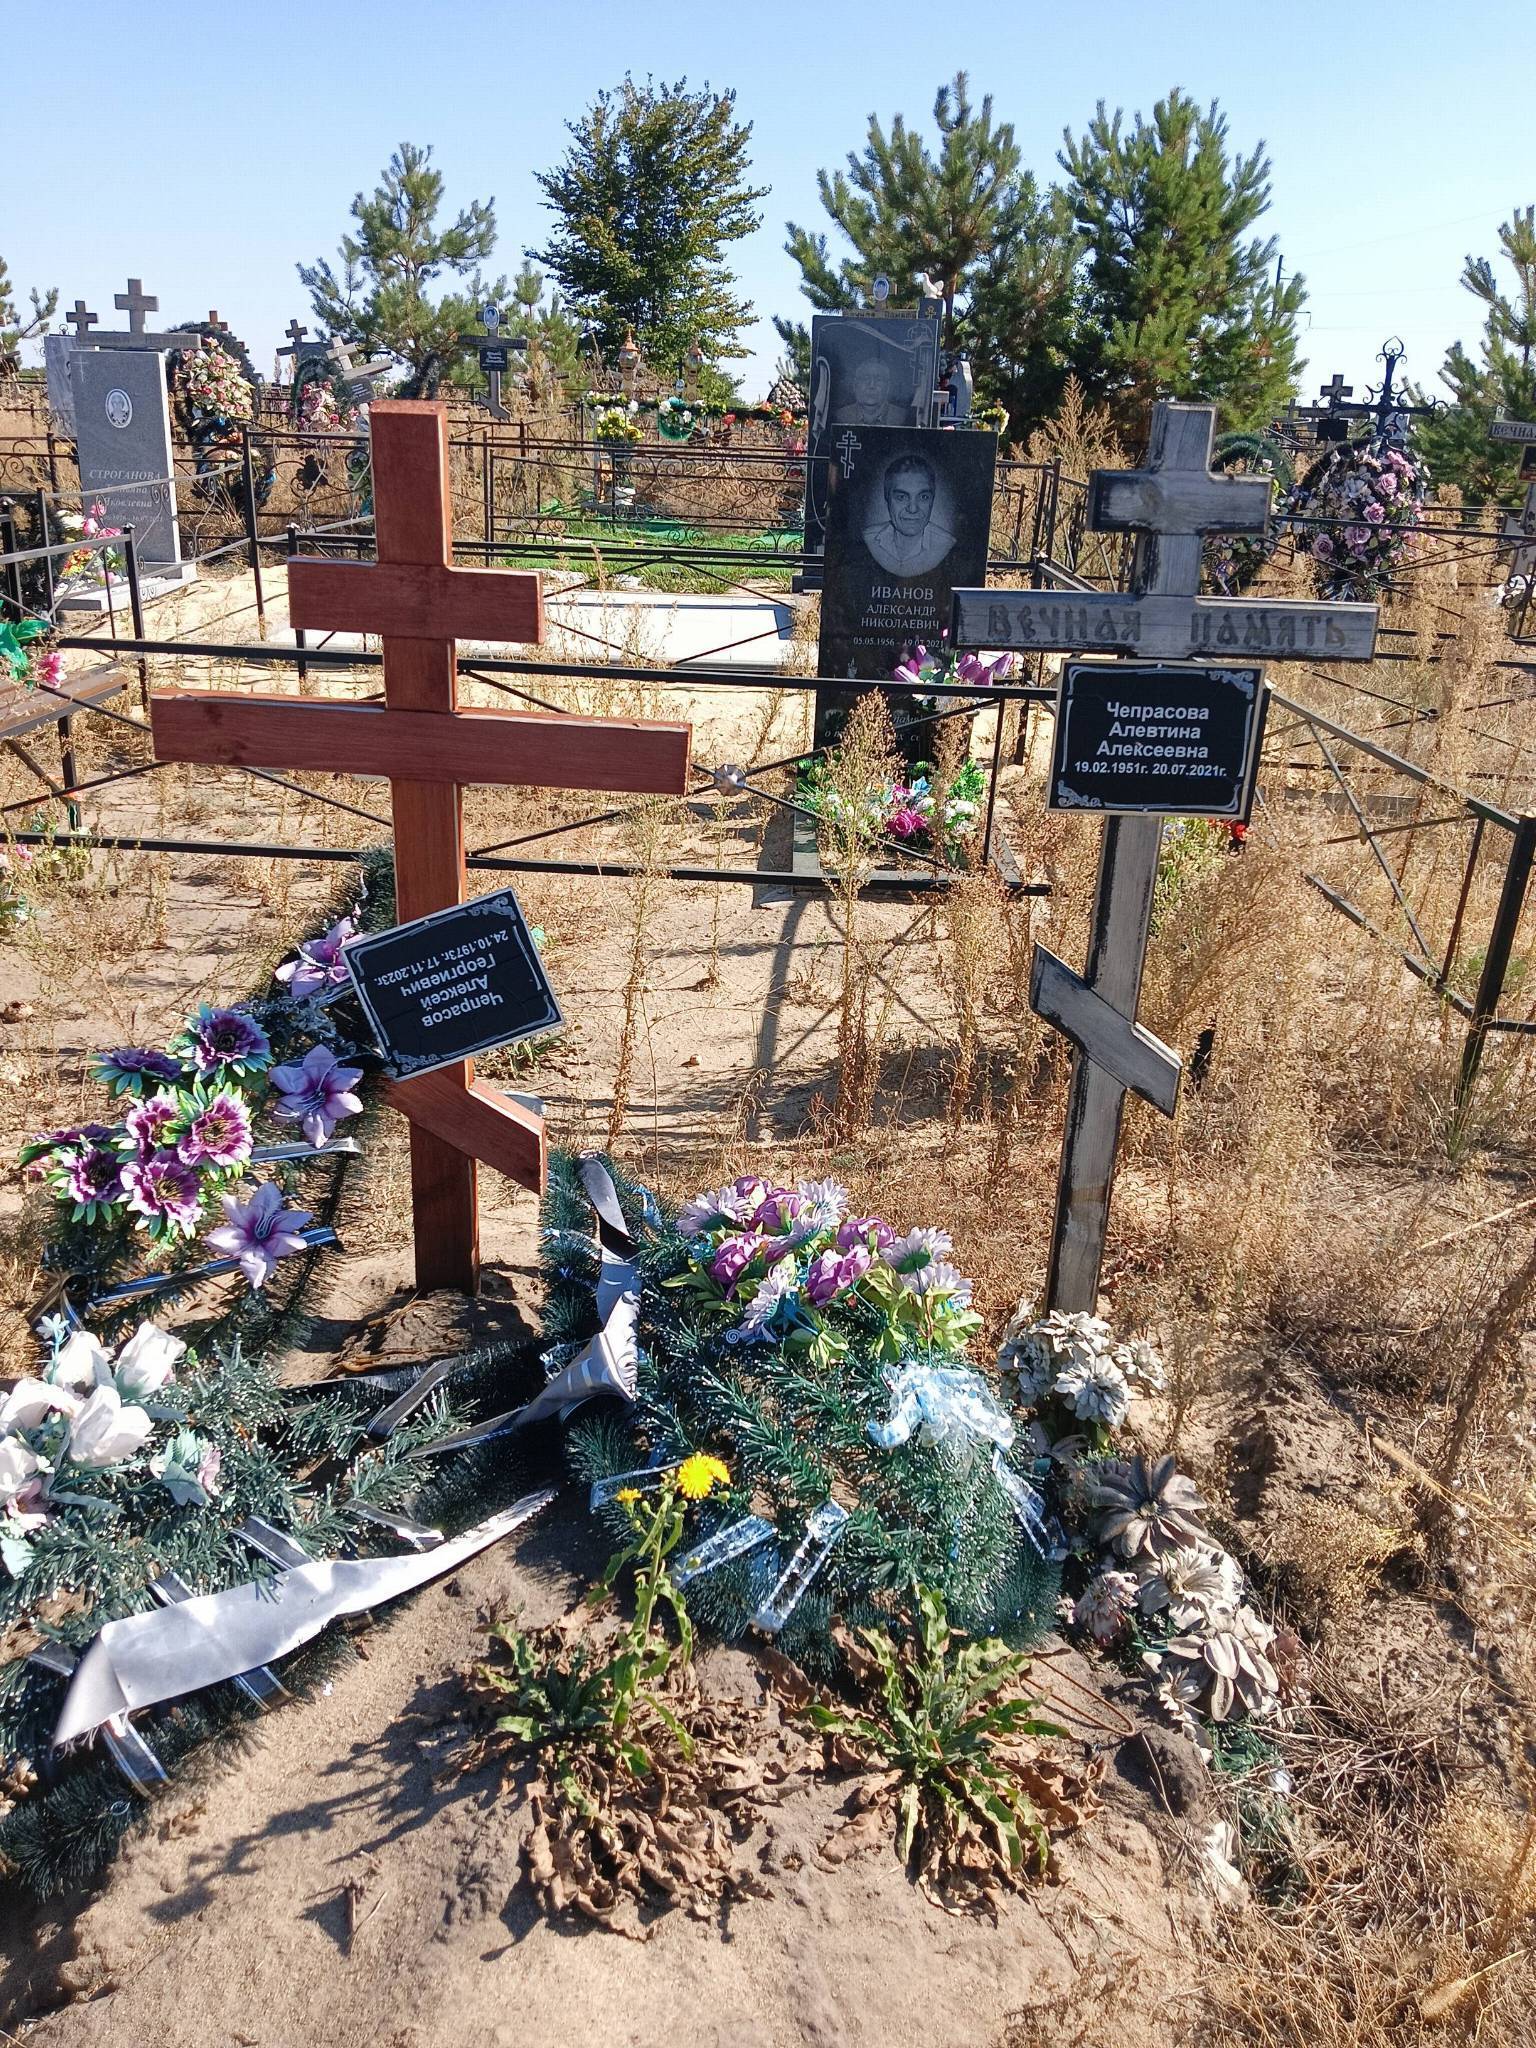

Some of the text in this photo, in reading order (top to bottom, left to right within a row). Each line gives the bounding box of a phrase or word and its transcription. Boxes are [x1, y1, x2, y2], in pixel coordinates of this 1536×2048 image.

[1493, 424, 1536, 438] ВЕЧНА
[89, 469, 160, 480] СТРОГАНОВА
[871, 586, 934, 600] ИВАНОВ
[866, 604, 936, 617] АЛЕКСАНДР
[861, 617, 939, 630] НИКОЛАЕВИЧ
[987, 605, 1347, 649] ВЕЧНАЯ ПАМЯТЬ
[1107, 701, 1210, 722] Чепрасова
[1108, 721, 1201, 739] Алевтина
[1096, 740, 1209, 759] Алексеевна
[1074, 761, 1227, 777] 19.02.1951г. 20.07.2021г.
[374, 930, 509, 986] 24.10.1973г. 17.11.2023г.
[400, 953, 496, 997] Георгиевич
[420, 974, 489, 1011] Алексей
[421, 992, 504, 1027] Чепрасов
